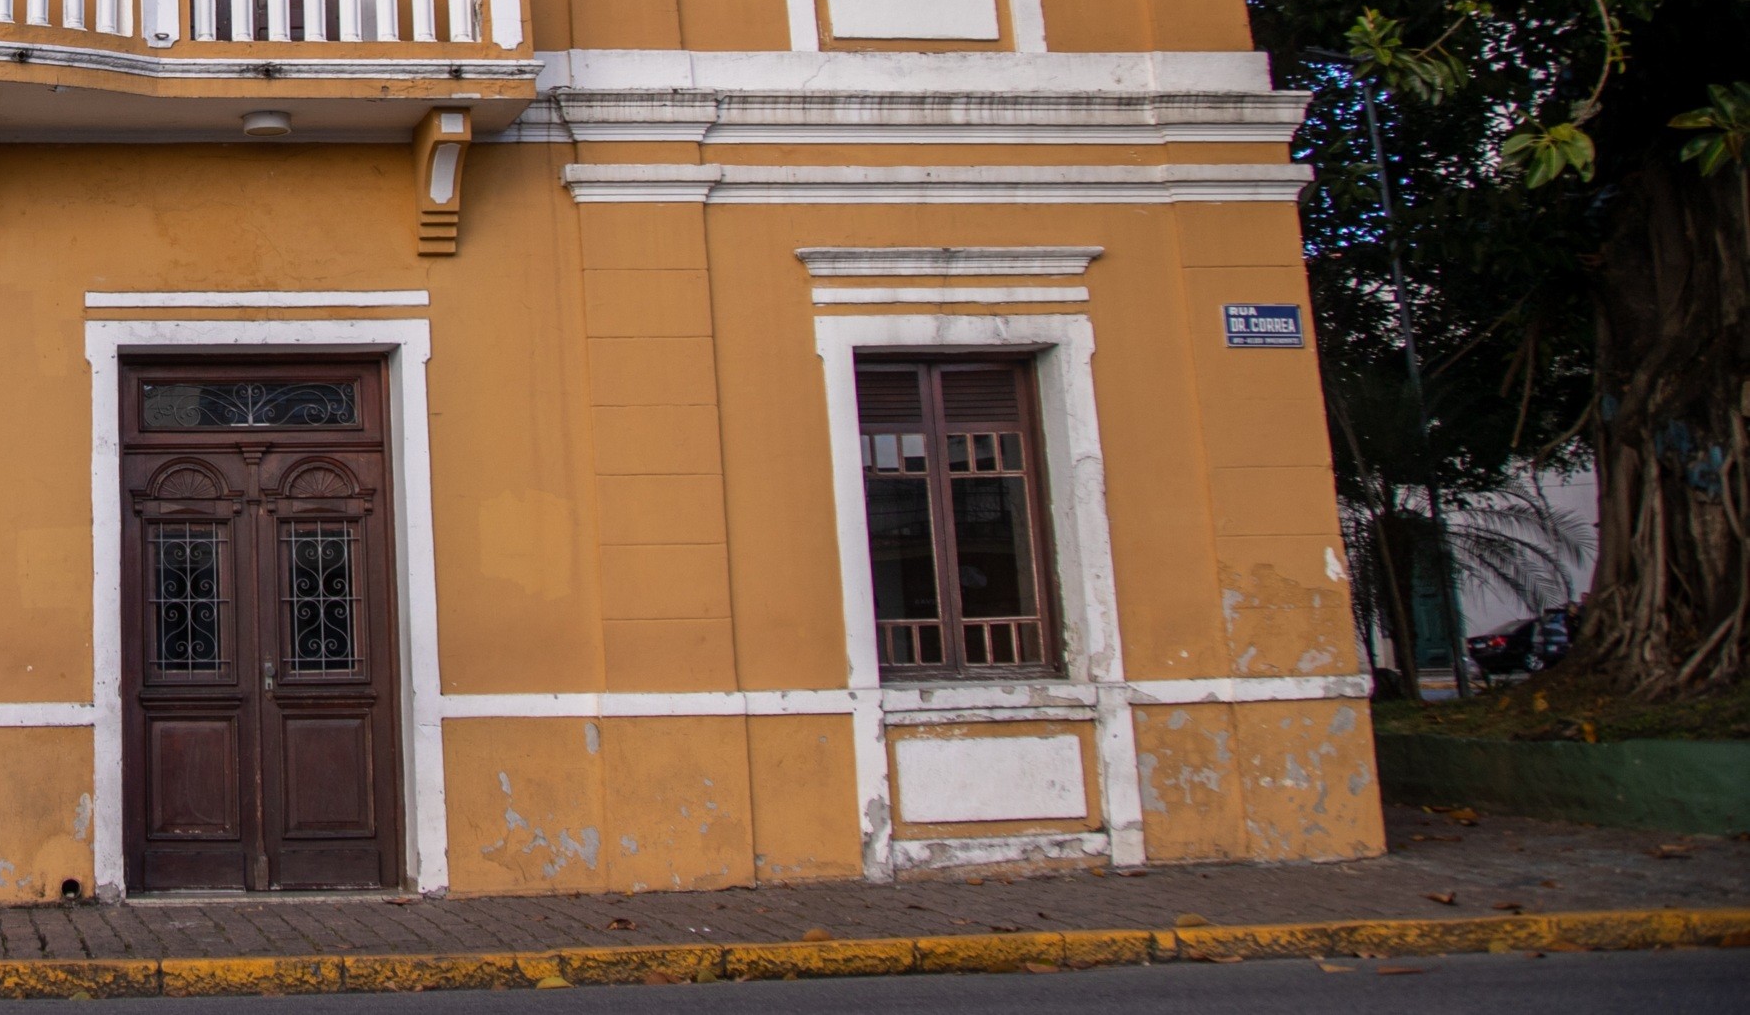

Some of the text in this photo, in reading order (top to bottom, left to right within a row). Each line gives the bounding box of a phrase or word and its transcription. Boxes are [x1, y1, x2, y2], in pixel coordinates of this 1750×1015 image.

[1228, 306, 1258, 316] RUA
[1230, 317, 1296, 333] DR. CORREA
